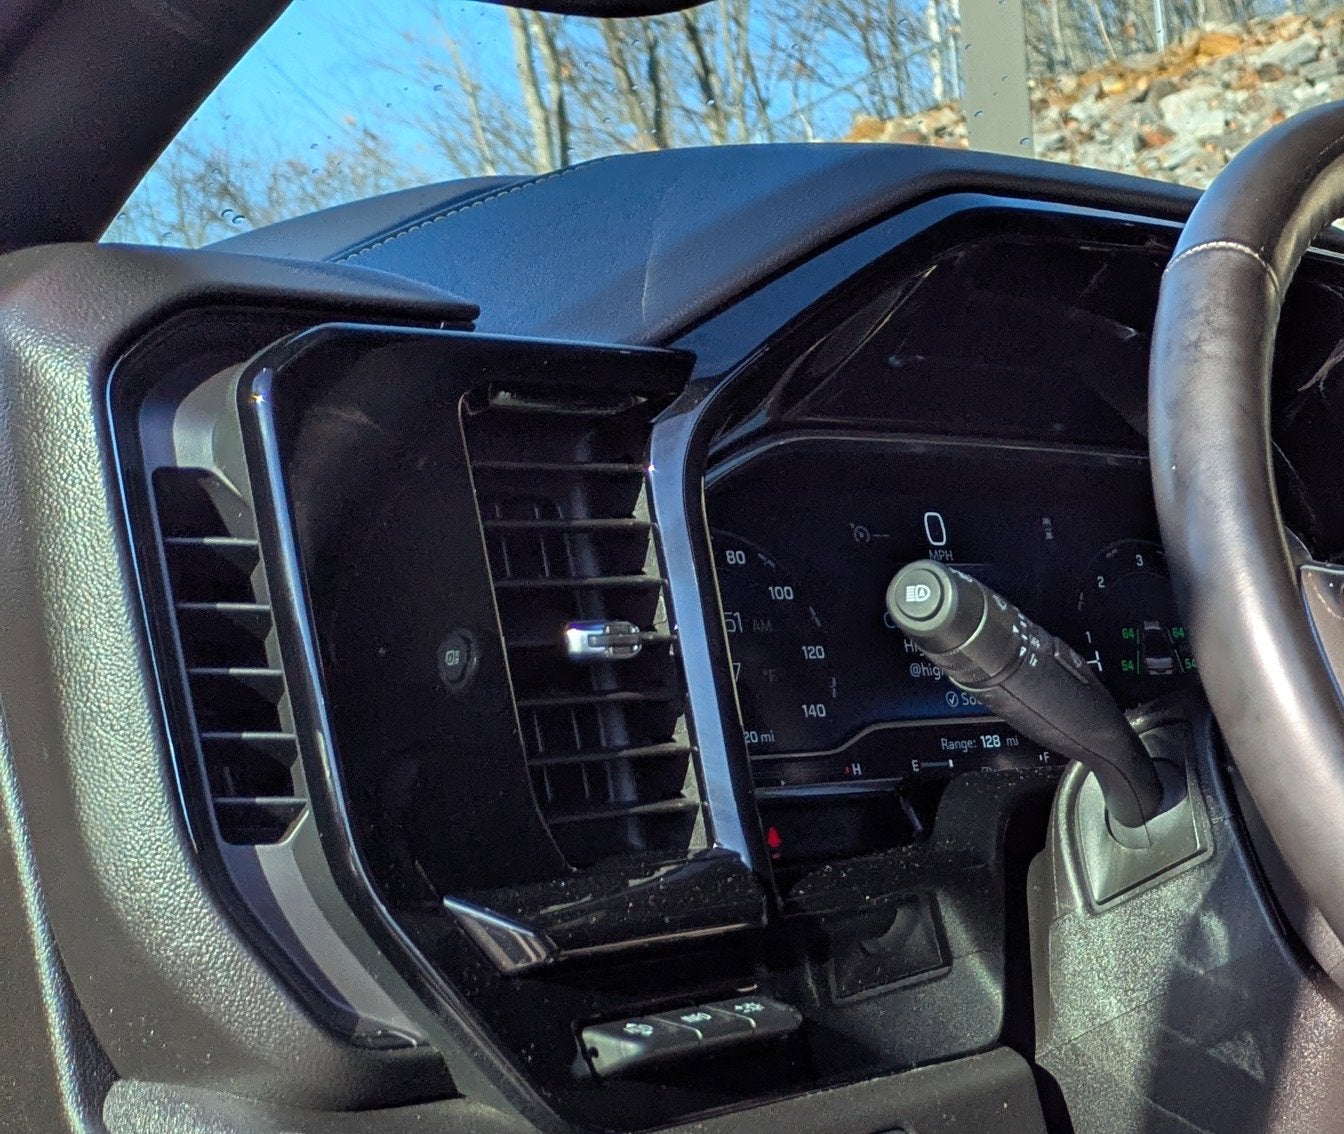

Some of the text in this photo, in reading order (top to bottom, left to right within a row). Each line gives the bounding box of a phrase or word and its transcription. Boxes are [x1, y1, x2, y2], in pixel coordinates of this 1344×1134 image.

[924, 512, 946, 546] 0
[726, 550, 746, 565] 80
[929, 549, 953, 561] MPH
[1135, 554, 1144, 566] 3
[1097, 575, 1106, 588] 2
[768, 585, 794, 601] 100
[1085, 631, 1092, 644] 1
[1121, 627, 1135, 639] 64
[1172, 627, 1186, 638] 64
[802, 645, 826, 660] 120
[1121, 659, 1135, 672] 54
[802, 703, 827, 718] 140
[760, 729, 775, 743] mi
[941, 734, 1020, 753] Range: 128 mi
[852, 763, 862, 776] H
[911, 759, 920, 772] E
